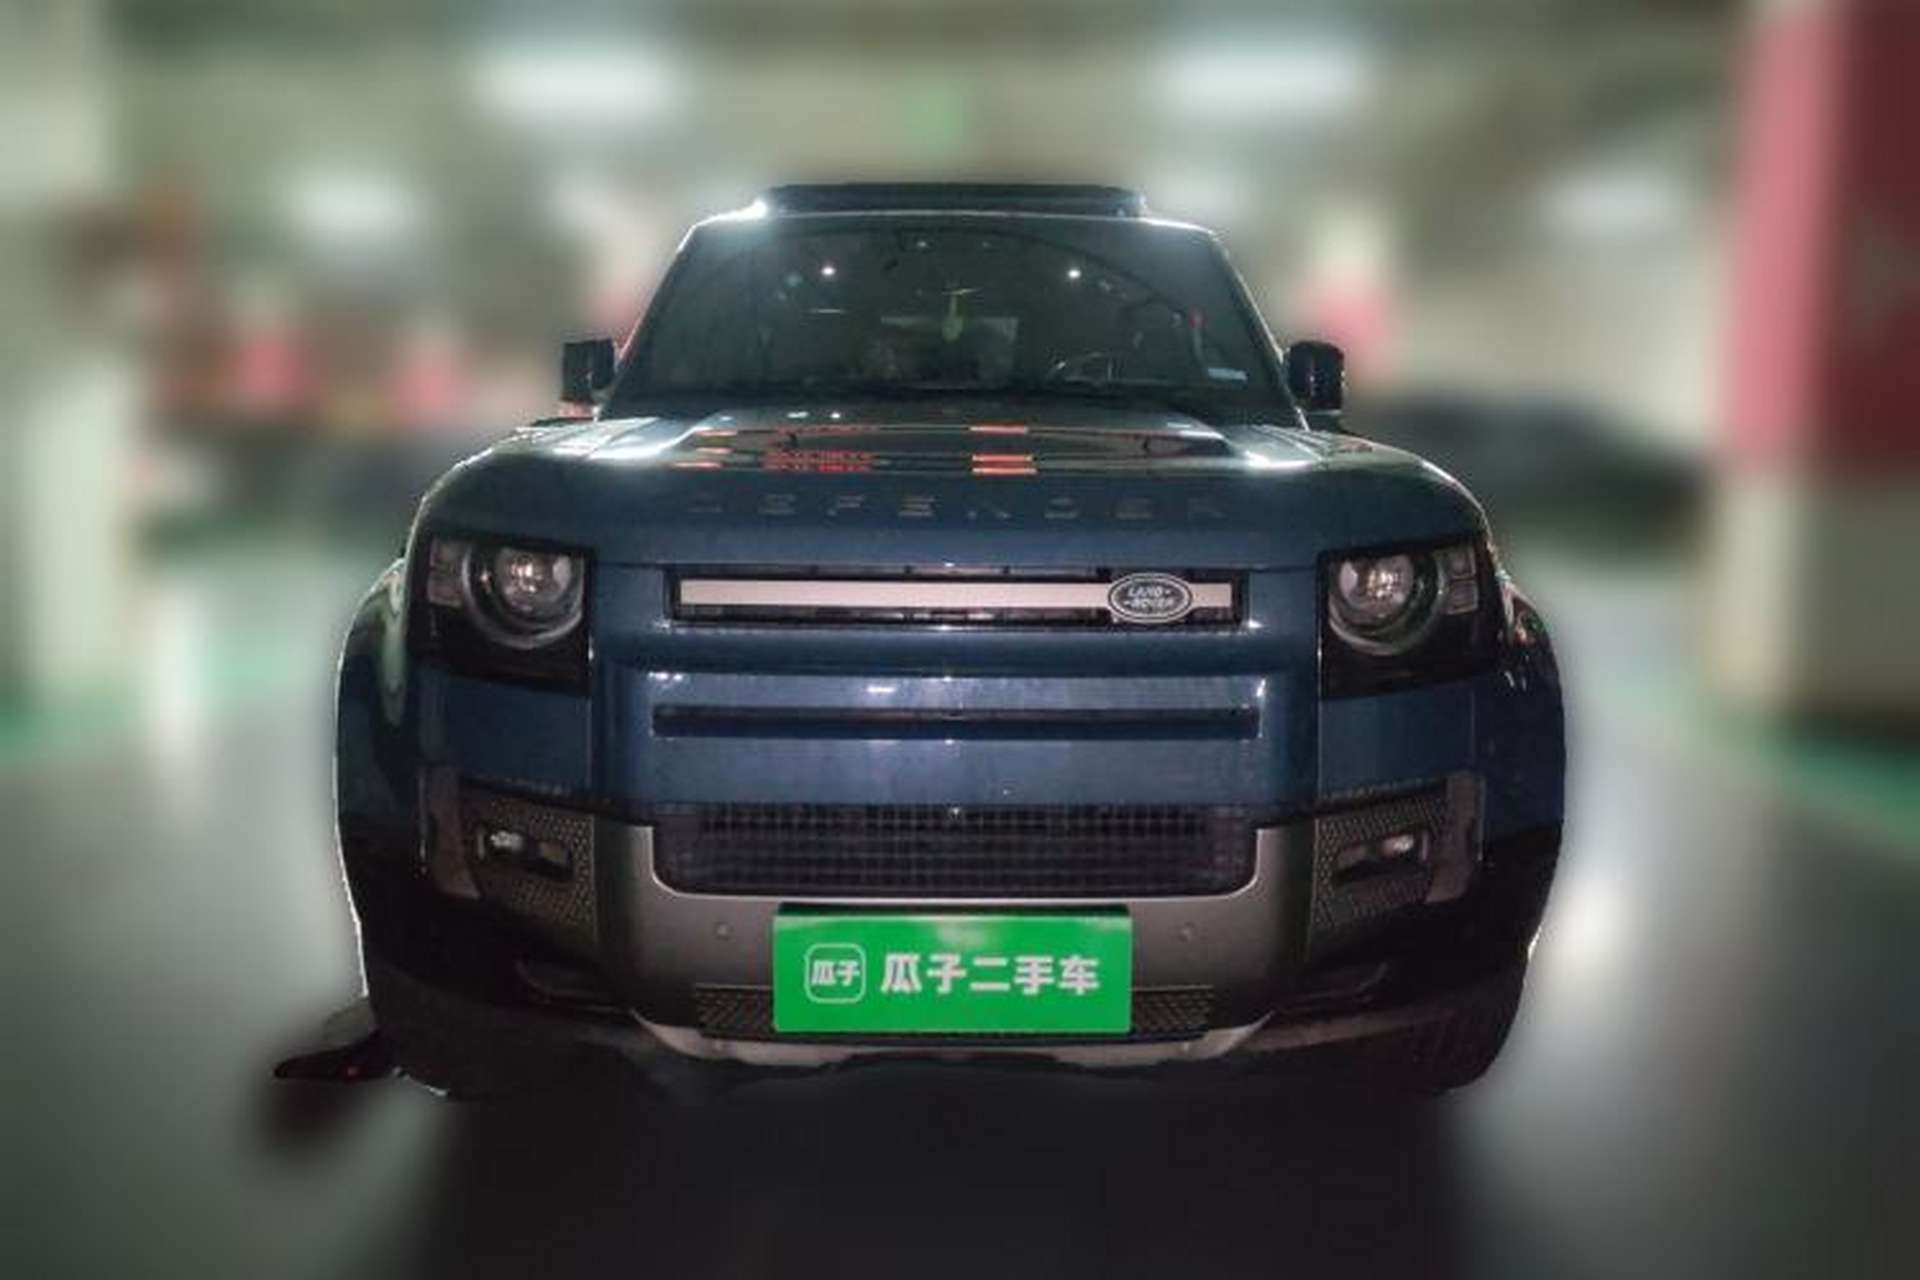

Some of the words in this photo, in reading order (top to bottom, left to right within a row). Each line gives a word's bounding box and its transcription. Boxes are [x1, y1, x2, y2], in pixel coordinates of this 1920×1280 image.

[811, 960, 861, 986] 瓜子
[881, 952, 1100, 996] 瓜子二手车
